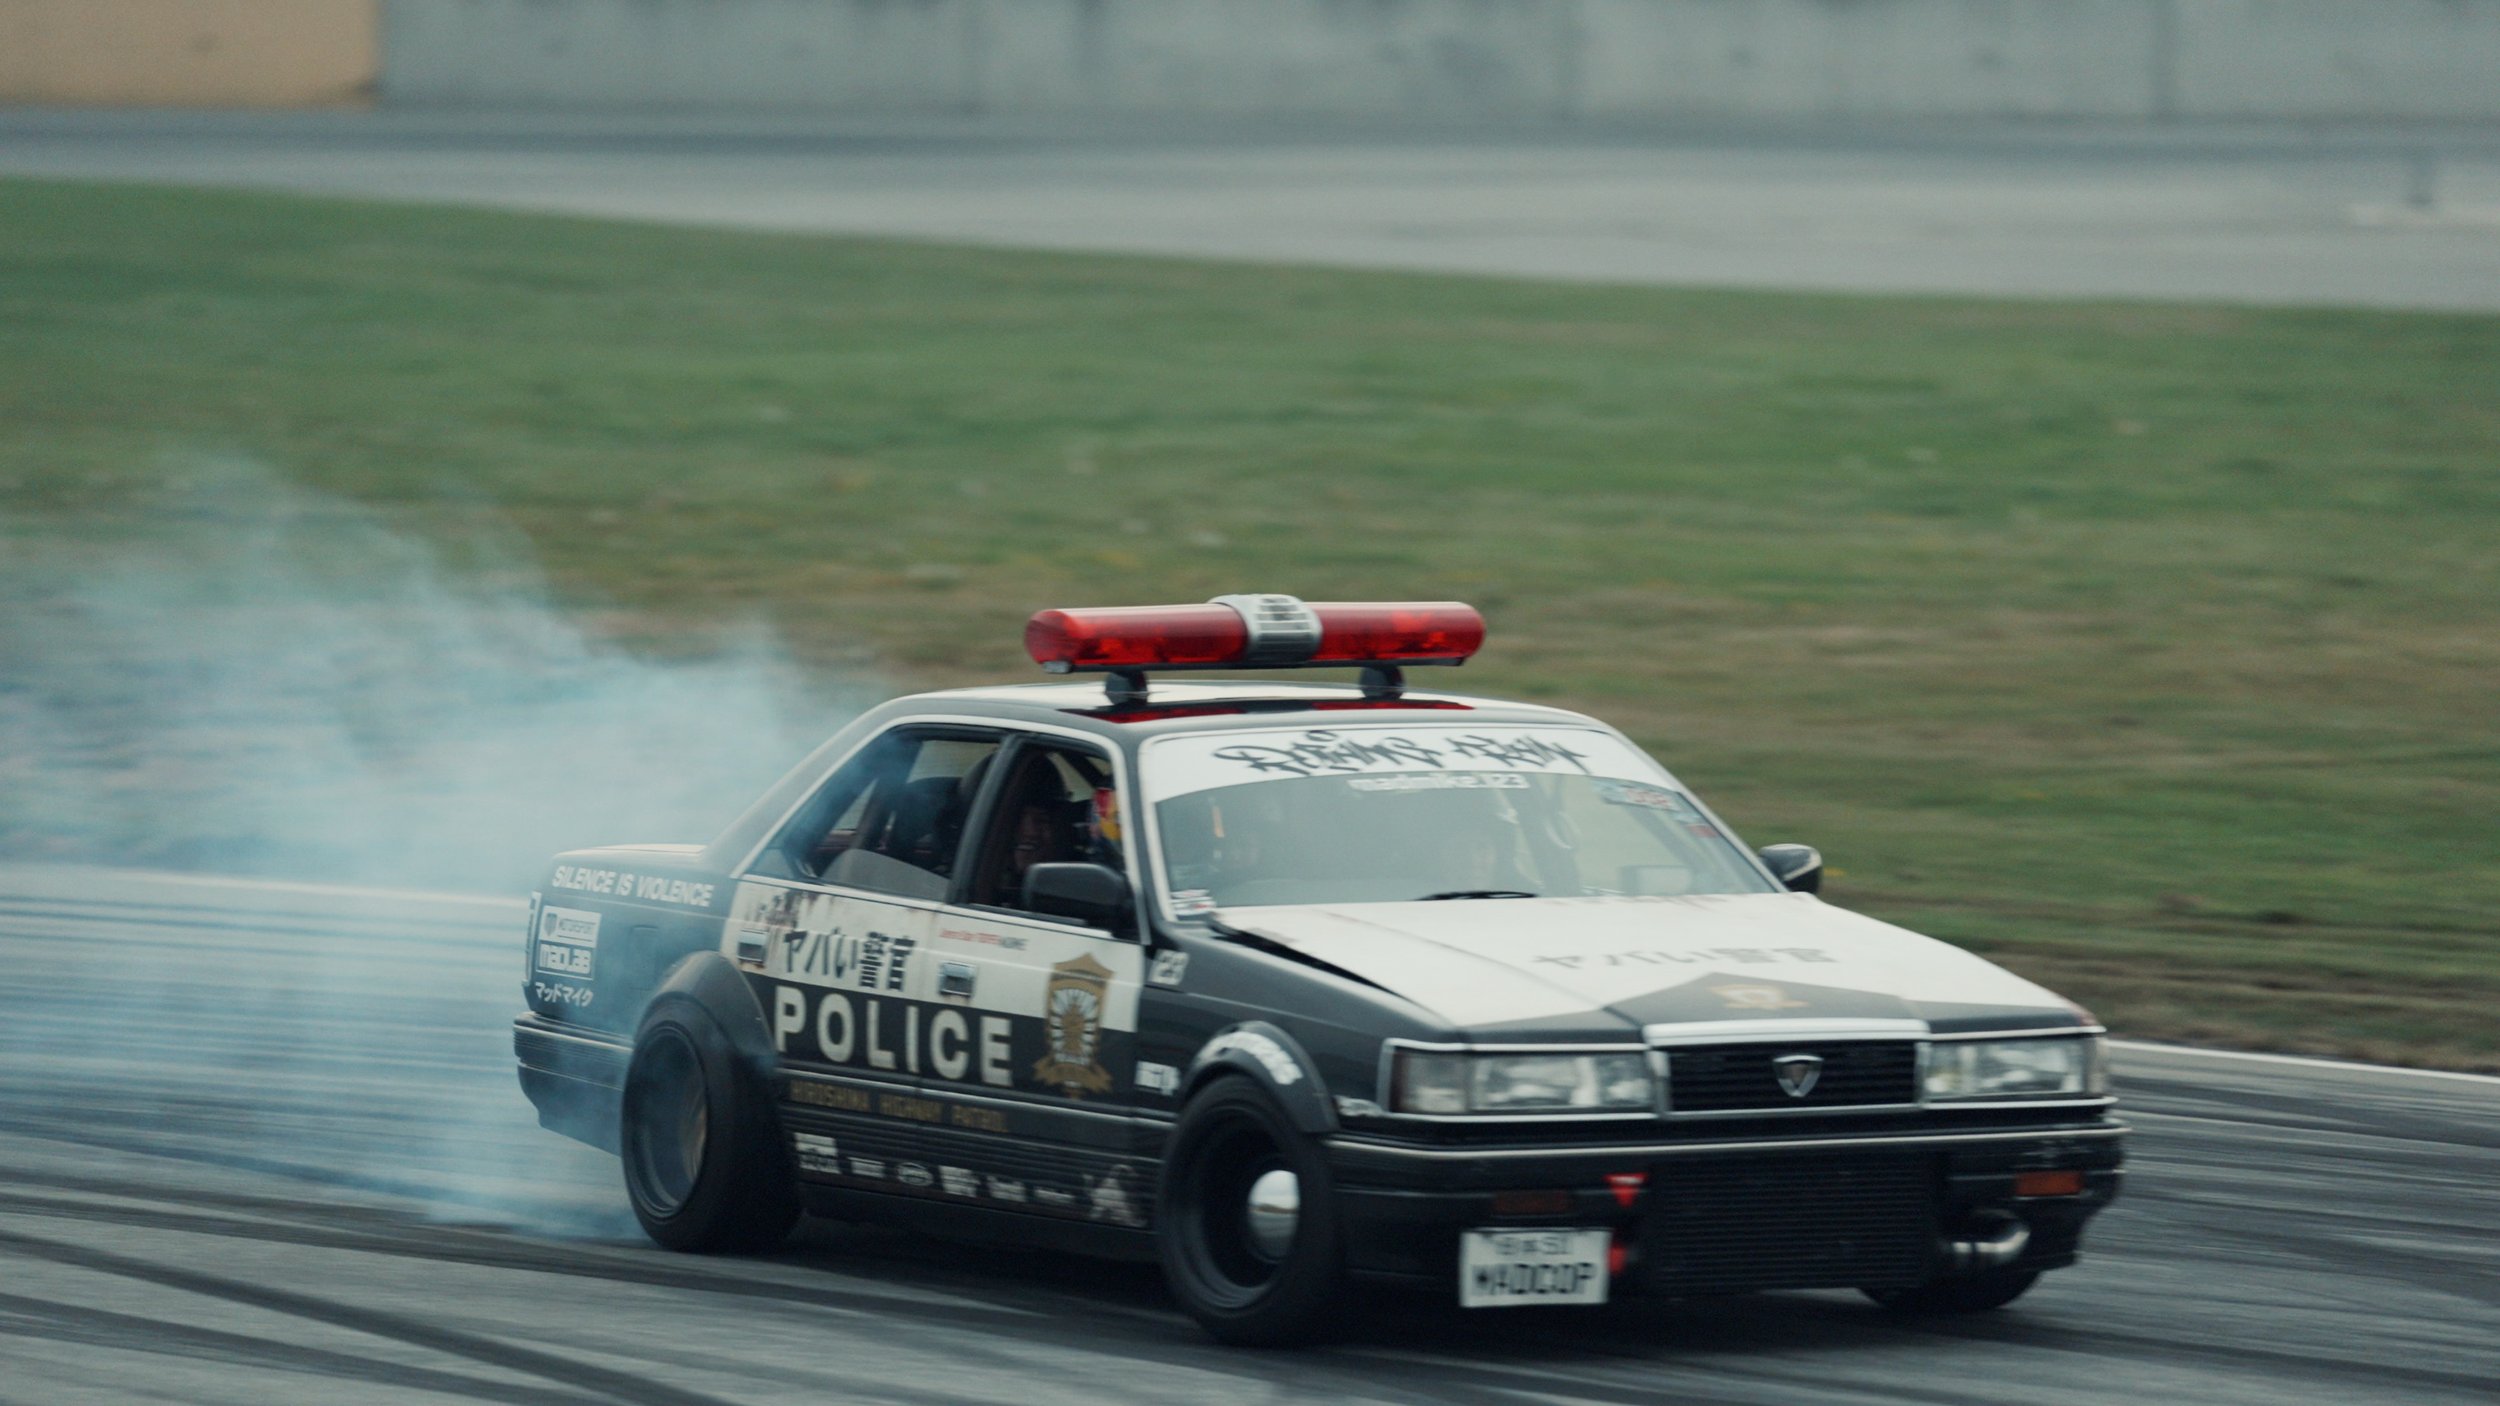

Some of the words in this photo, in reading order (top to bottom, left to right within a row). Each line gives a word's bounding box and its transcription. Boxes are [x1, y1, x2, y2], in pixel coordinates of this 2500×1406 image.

[552, 865, 612, 894] SILENCE
[615, 872, 635, 896] IS
[636, 876, 715, 907] VIOLENCE
[535, 982, 594, 1007] マッドマイク
[774, 986, 1013, 1087] POLICE
